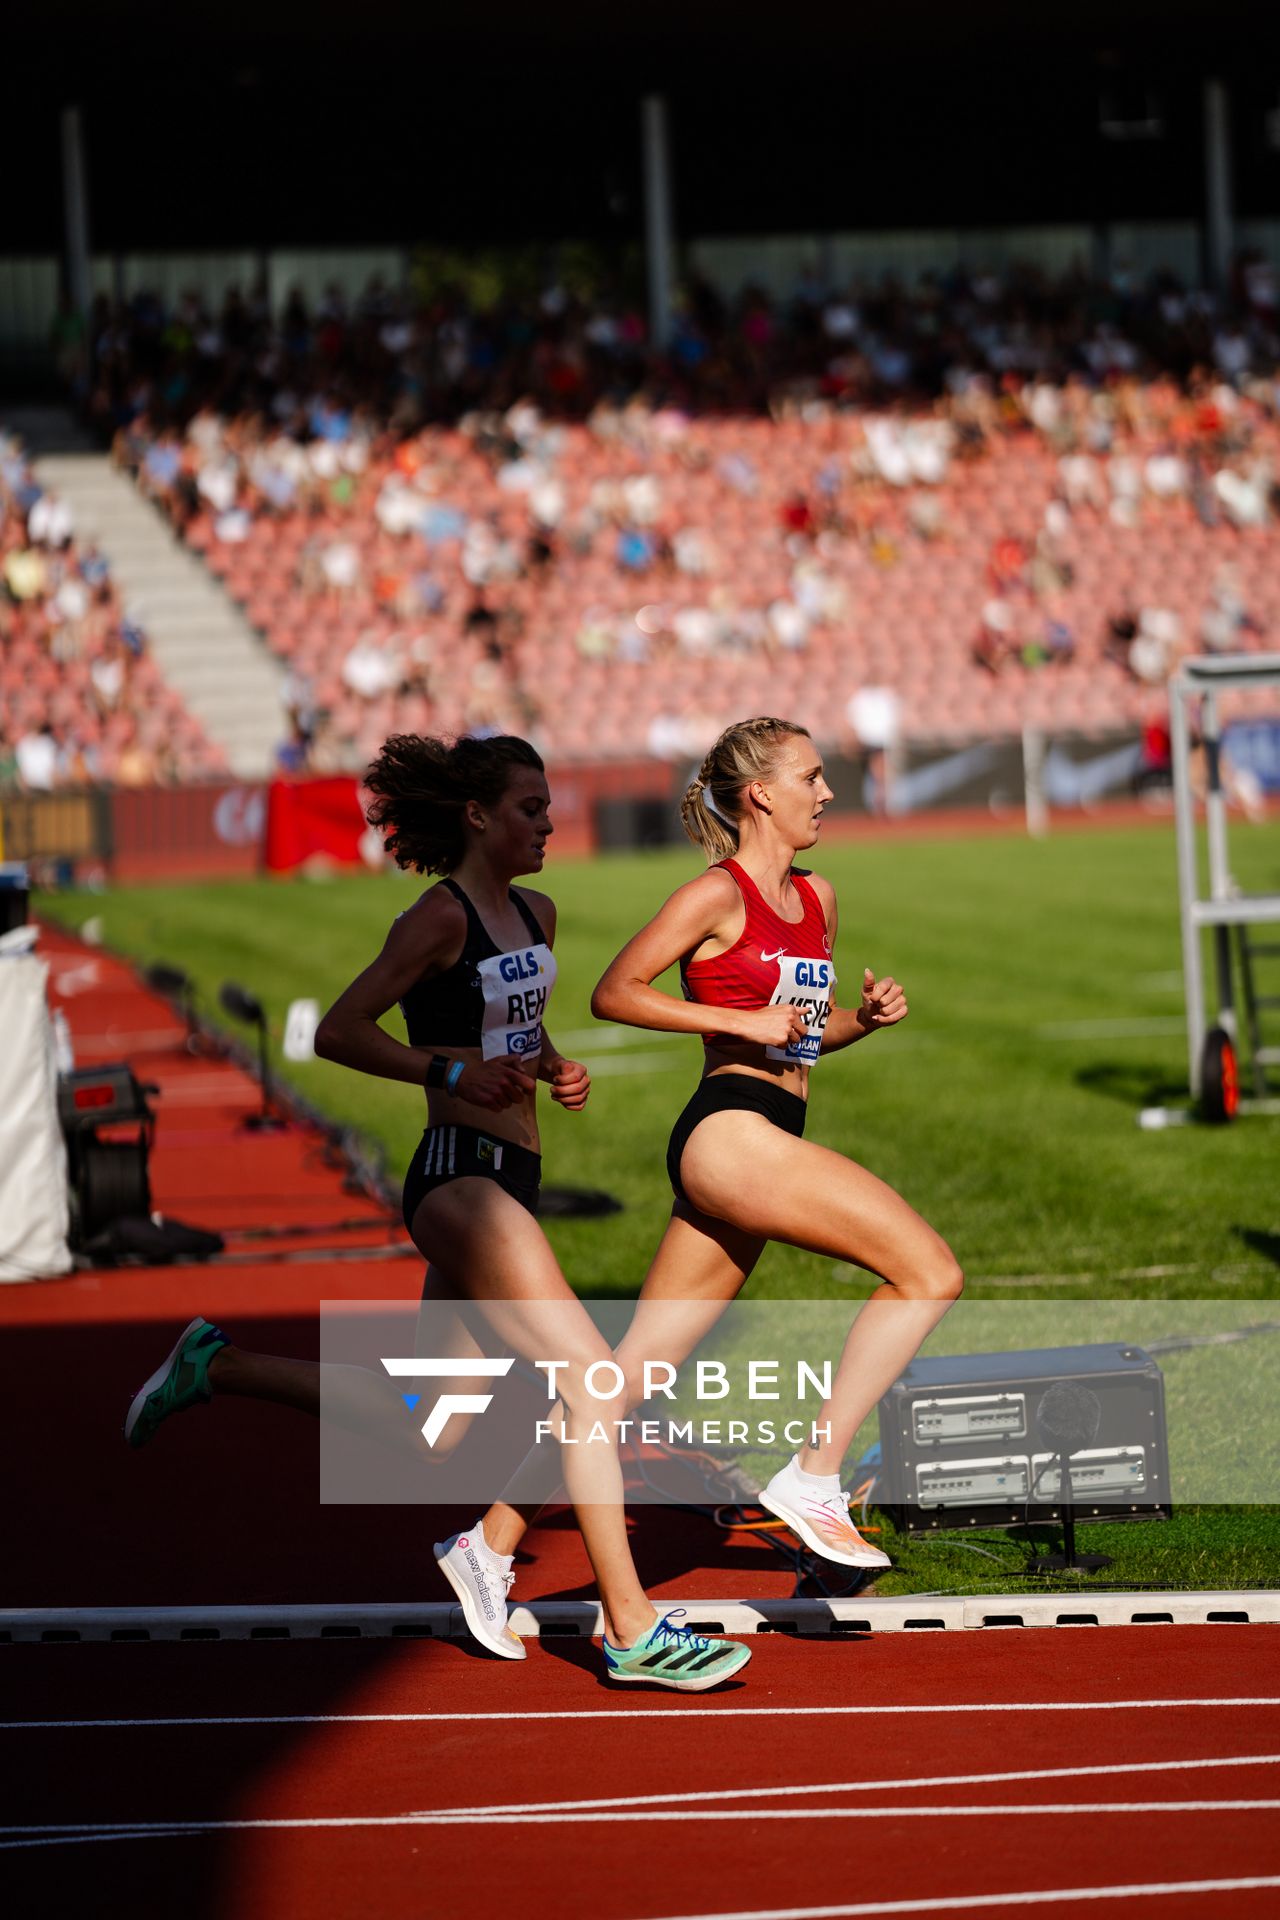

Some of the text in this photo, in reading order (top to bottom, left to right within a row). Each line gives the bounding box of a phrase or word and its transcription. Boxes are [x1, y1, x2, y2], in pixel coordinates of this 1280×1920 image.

[506, 986, 546, 1024] REH
[464, 1548, 497, 1622] new balance
